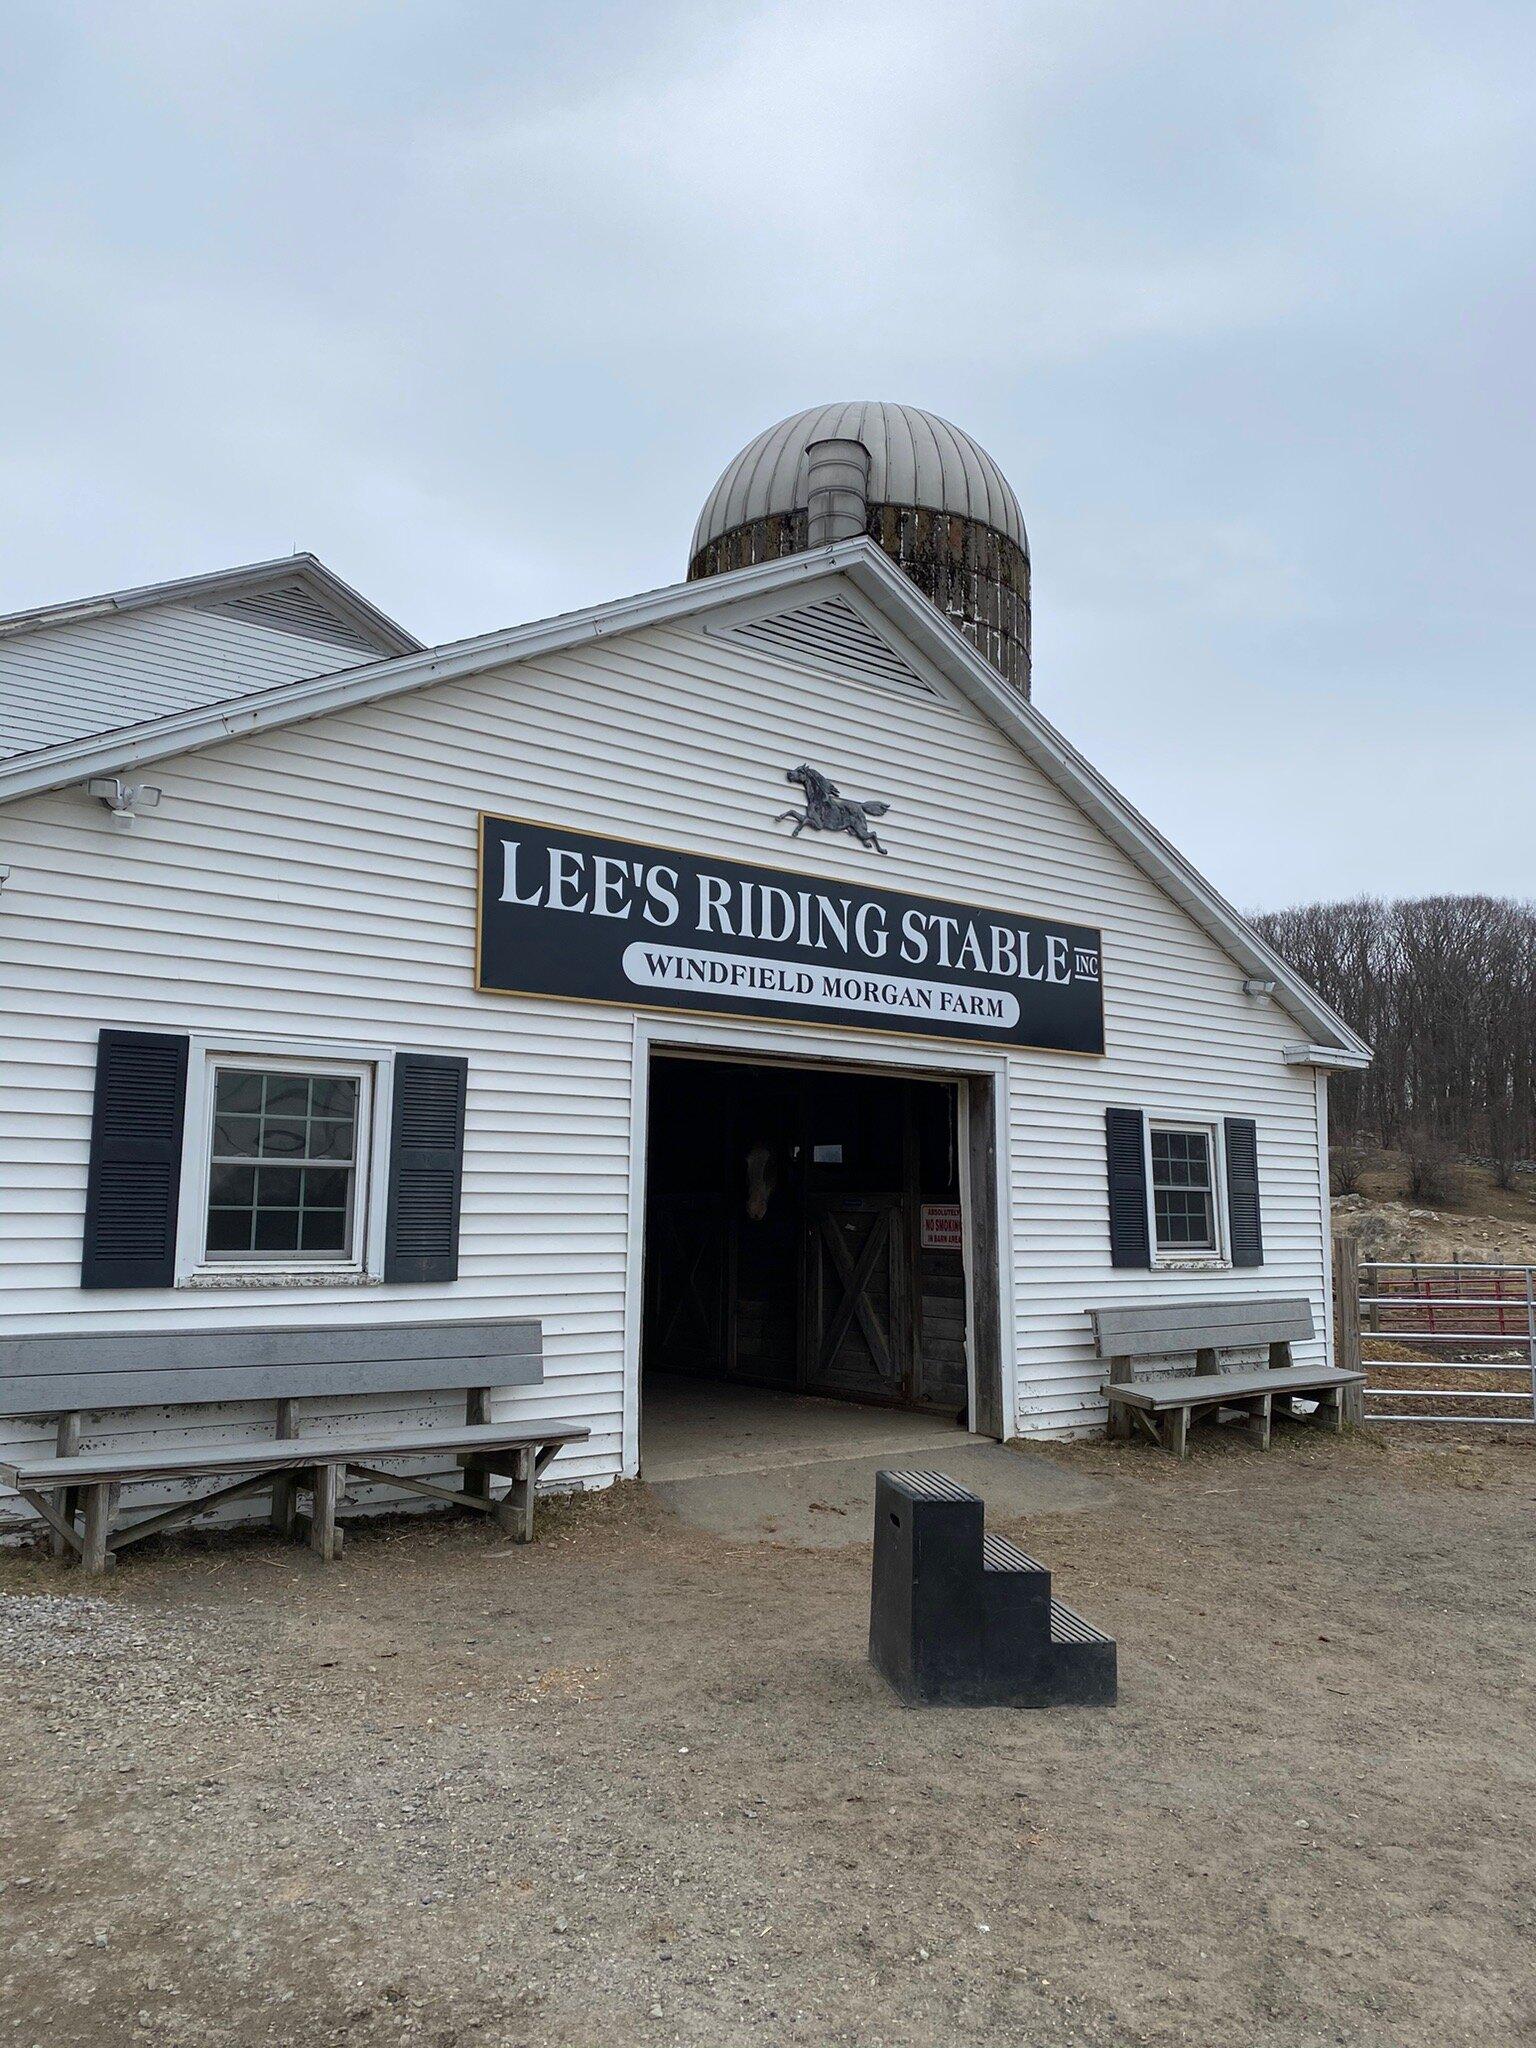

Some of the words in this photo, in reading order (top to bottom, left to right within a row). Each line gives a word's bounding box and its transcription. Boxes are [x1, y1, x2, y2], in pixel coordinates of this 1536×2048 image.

[499, 839, 680, 927] LEE'S
[695, 873, 889, 958] RIDING
[900, 909, 1072, 985] STABLE
[1076, 953, 1098, 976] INC
[643, 952, 814, 994] WINDFIELD
[823, 976, 932, 1010] MORGAN
[940, 991, 1004, 1018] FARM
[925, 1219, 935, 1231] NO
[934, 1234, 948, 1243] BARN
